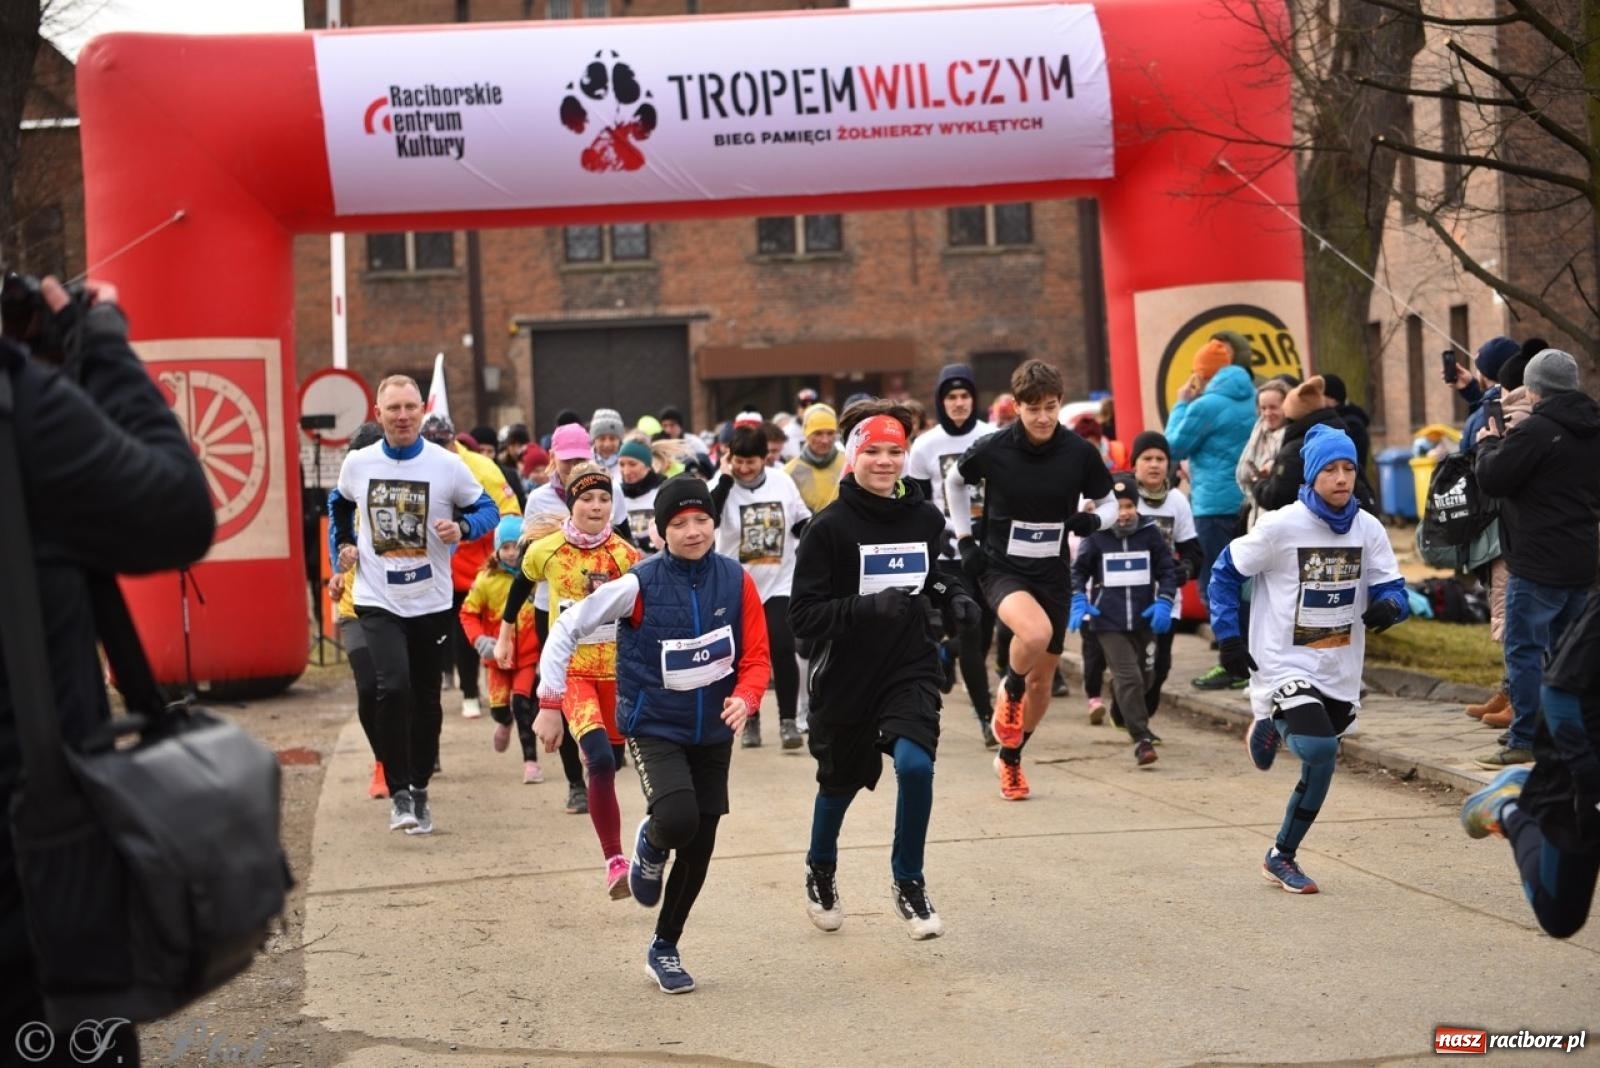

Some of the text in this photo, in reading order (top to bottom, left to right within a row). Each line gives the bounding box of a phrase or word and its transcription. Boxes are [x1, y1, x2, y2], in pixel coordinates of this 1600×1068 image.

[667, 54, 1074, 120] TROPEMWILCZYM
[390, 82, 503, 107] Raciborskie
[714, 117, 1043, 146] BIEG PAMIĘCI ŻOŁNIERZY WYKLĘTYCH
[396, 134, 465, 160] Kultury
[1031, 531, 1044, 541] 47
[888, 557, 905, 569] 44
[404, 572, 417, 582] 39
[1327, 593, 1340, 604] 75
[692, 649, 710, 663] 40
